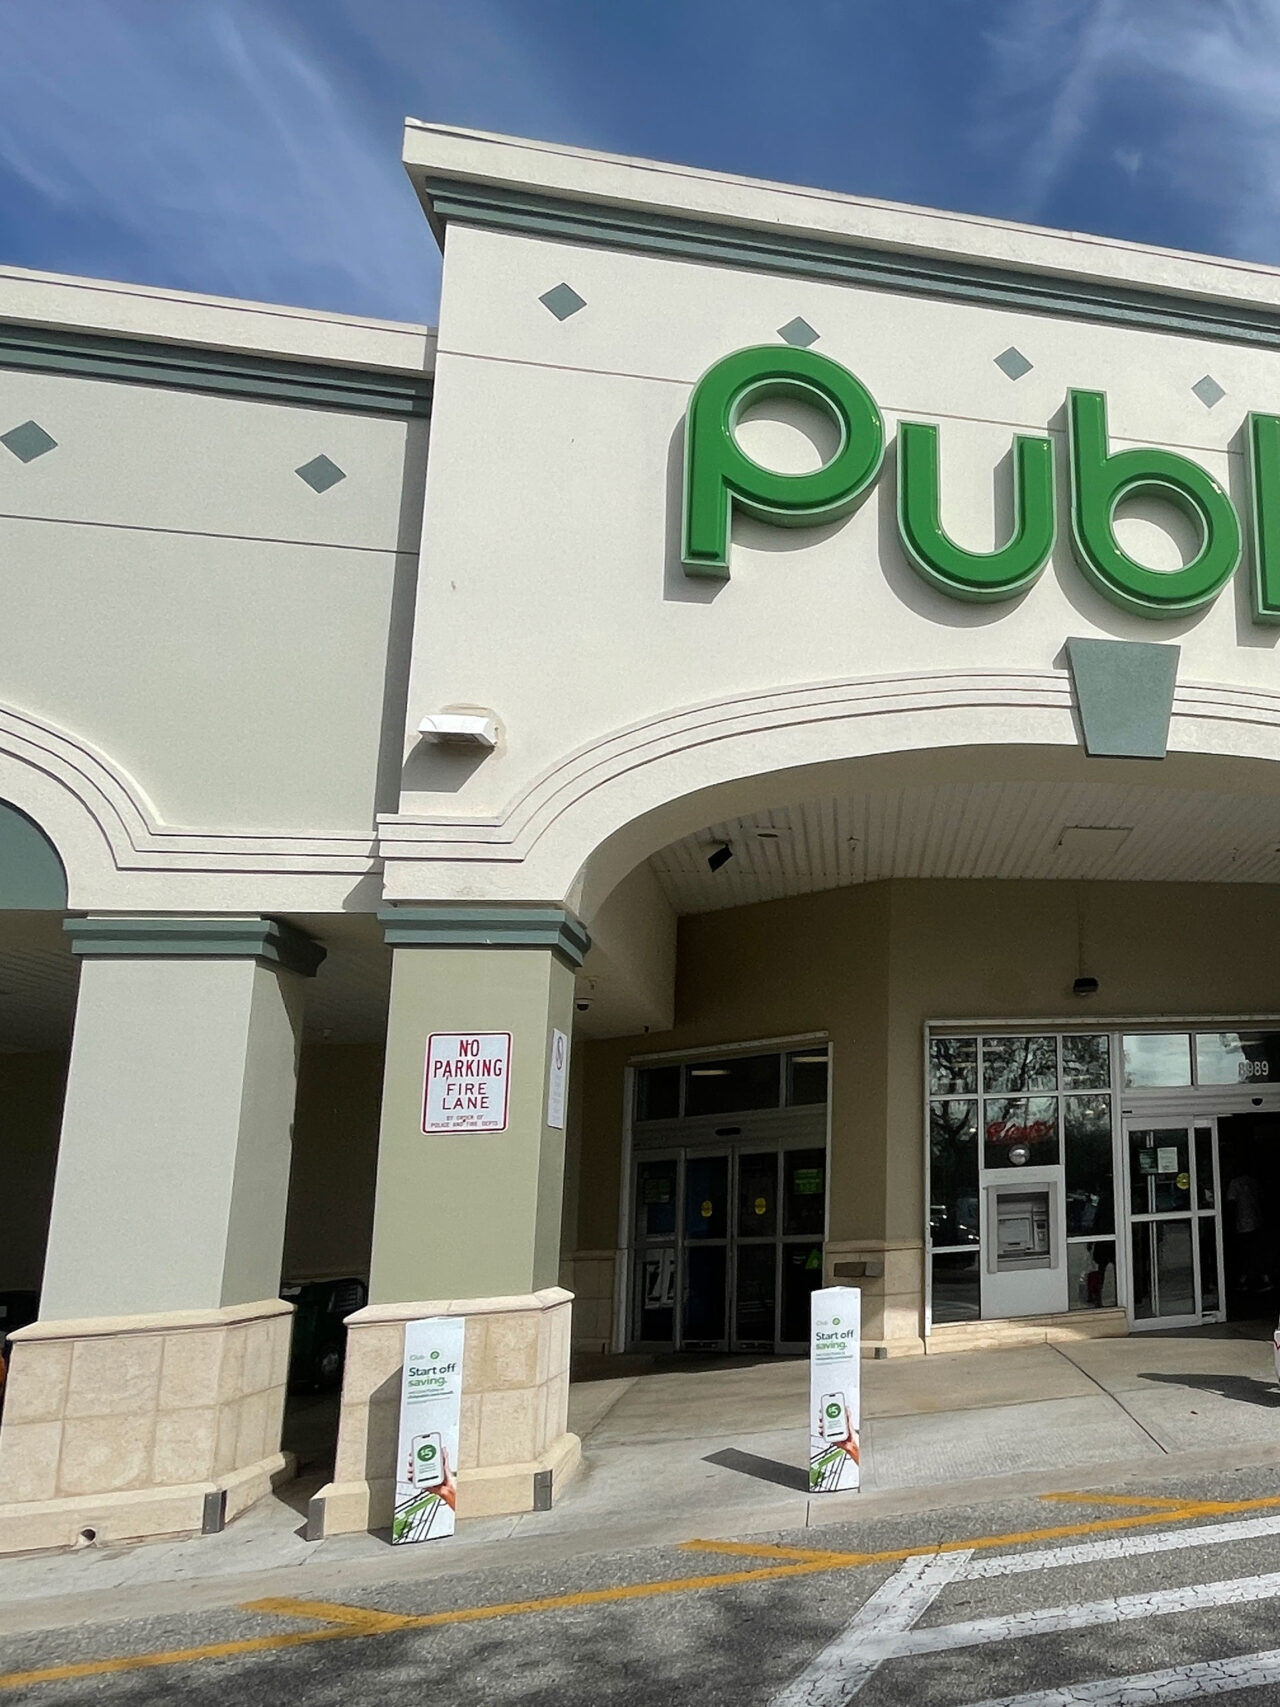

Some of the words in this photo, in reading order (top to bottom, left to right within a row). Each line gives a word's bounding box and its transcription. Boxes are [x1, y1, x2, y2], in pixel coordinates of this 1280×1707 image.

[459, 1038, 480, 1057] NO
[433, 1059, 503, 1078] PARKING
[1238, 1060, 1269, 1077] 8989
[446, 1082, 487, 1096] FIRE
[442, 1097, 490, 1111] LANE
[815, 1331, 839, 1341] Start
[840, 1328, 854, 1339] off
[815, 1341, 848, 1351] saving.
[408, 1366, 437, 1377] Start
[439, 1361, 457, 1374] off
[408, 1376, 448, 1388] saving.
